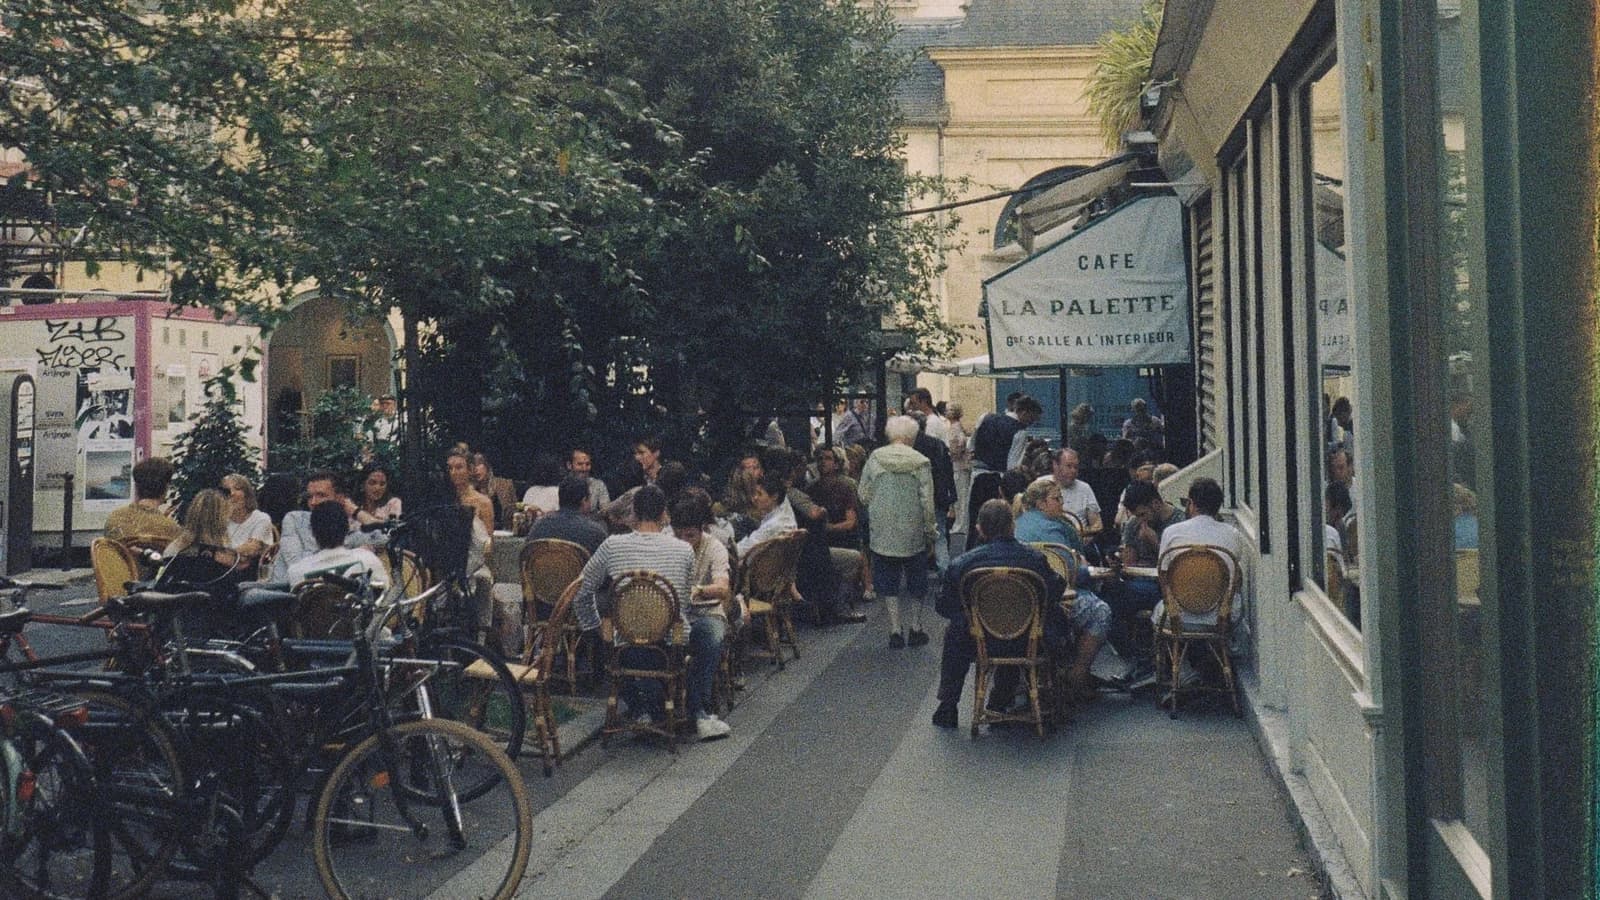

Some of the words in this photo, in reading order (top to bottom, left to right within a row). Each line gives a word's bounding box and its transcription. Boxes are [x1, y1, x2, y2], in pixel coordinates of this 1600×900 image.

[1078, 253, 1134, 270] CAFE
[1002, 299, 1037, 316] LA
[1051, 295, 1174, 316] PALETTE
[1028, 335, 1070, 347] SALLE
[1075, 335, 1084, 346] A
